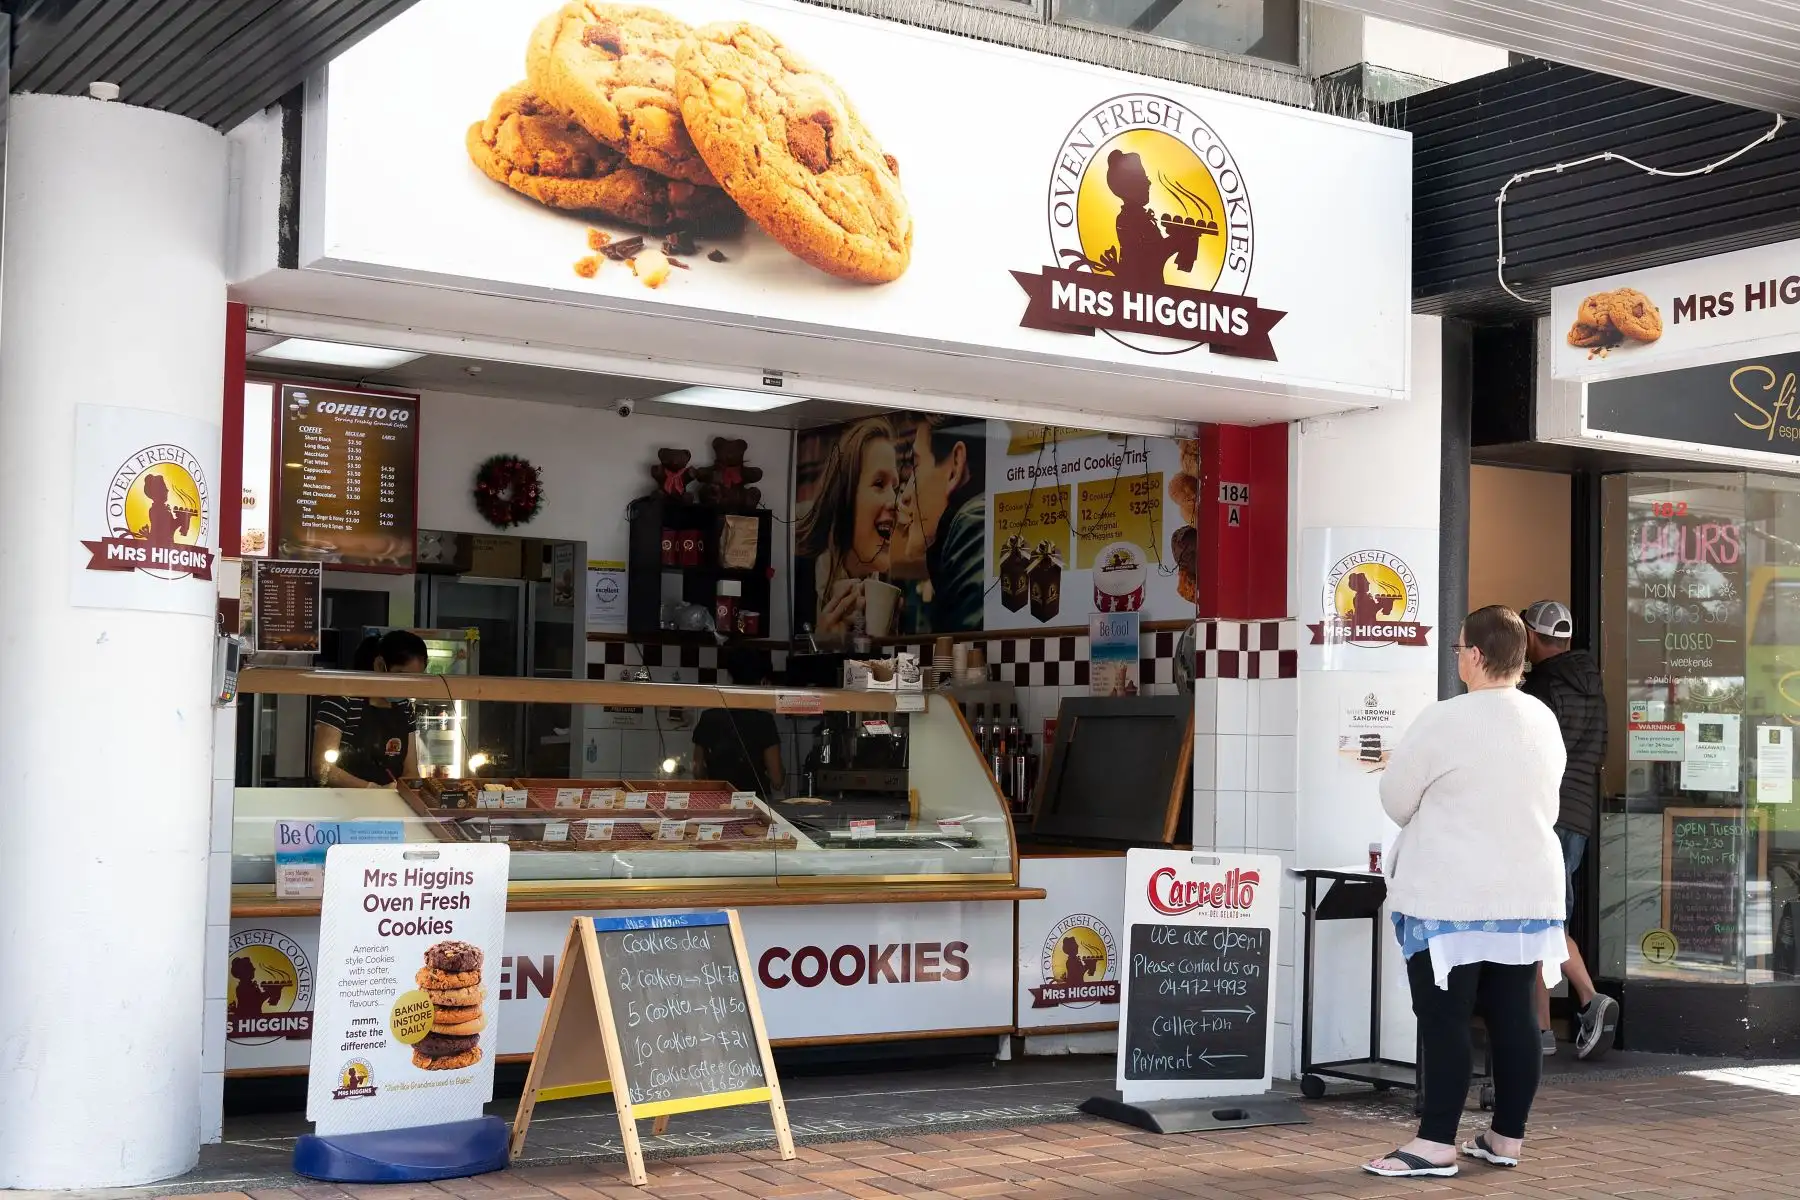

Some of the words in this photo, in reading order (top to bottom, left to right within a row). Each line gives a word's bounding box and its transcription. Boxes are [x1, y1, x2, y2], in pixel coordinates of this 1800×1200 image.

[1053, 128, 1096, 228] OVEN
[1092, 99, 1184, 137] FRESH
[1191, 127, 1248, 274] COOKIES
[1051, 280, 1114, 317] MRS
[1122, 290, 1249, 337] HIGGINS
[1673, 291, 1734, 325] MRS
[316, 401, 368, 417] COFFEE
[369, 407, 387, 419] TO
[389, 409, 410, 422] GO
[298, 425, 323, 434] COFFEE
[1006, 467, 1025, 482] Gift
[1028, 464, 1058, 480] Boxes
[1061, 458, 1081, 474] and
[1084, 453, 1123, 470] Cookie
[1123, 451, 1148, 465] Tins
[109, 465, 137, 518] OVEN
[135, 447, 185, 469] FRESH
[187, 460, 207, 536] COOKIES
[1081, 490, 1089, 501] 9
[1220, 484, 1249, 503] 184
[1081, 509, 1092, 520] 12
[1228, 508, 1240, 525] A
[1651, 502, 1689, 518] 182
[998, 519, 1008, 530] 12
[1641, 523, 1739, 565] HOURS
[107, 543, 147, 562] MRS
[151, 548, 207, 569] HIGGINS
[1341, 551, 1387, 570] FRESH
[1389, 558, 1417, 614] COOKIES
[1644, 583, 1676, 599] MON
[1099, 621, 1110, 637] Be
[1111, 620, 1129, 637] Cool
[1322, 625, 1352, 638] MRS
[1355, 625, 1417, 639] HIGGINS
[1664, 632, 1713, 651] CLOSED
[1670, 656, 1713, 668] weekends
[1638, 723, 1677, 731] WARNING
[280, 824, 301, 845] Be
[305, 824, 341, 845] Cool
[1675, 822, 1706, 837] OPEN
[1710, 822, 1756, 838] TUESDAY
[1689, 851, 1715, 866] MON
[363, 868, 398, 888] Mrs
[403, 866, 474, 890] Higgins
[1147, 866, 1260, 916] Carrello
[363, 893, 414, 913] Oven
[420, 890, 470, 911] Fresh
[1209, 910, 1219, 918] DEL
[1220, 910, 1239, 919] GELATO
[377, 916, 453, 937] Cookies
[352, 945, 389, 954] American
[622, 930, 678, 955] Cookies
[1043, 933, 1059, 970] OVEN
[1057, 915, 1091, 933] FRESH
[1092, 921, 1115, 973] COOKIES
[1150, 925, 1179, 945] We
[1183, 928, 1208, 946] are
[1213, 927, 1263, 958] open!
[228, 931, 274, 953] RESH
[278, 938, 311, 1002] COOKIES
[345, 957, 364, 966] style
[365, 955, 395, 964] Cookies
[758, 940, 970, 990] COOKIES
[1133, 953, 1176, 978] Please
[1223, 960, 1240, 975] us
[1242, 964, 1260, 978] on
[349, 967, 365, 976] with
[367, 966, 390, 975] softer,
[619, 967, 632, 992] 2
[338, 978, 369, 987] chewier
[369, 977, 398, 986] centres,
[339, 987, 396, 999] mouthwatering
[1042, 988, 1066, 1000] MRS
[1068, 984, 1116, 998] HIGGINS
[394, 1000, 430, 1017] BAKING
[628, 1001, 641, 1027] 5
[238, 1017, 309, 1033] HIGGINS
[351, 1017, 379, 1026] mmm,
[393, 1010, 432, 1028] INSTORE
[1152, 1015, 1232, 1037] Collection
[345, 1029, 367, 1039] taste
[369, 1028, 384, 1037] the
[400, 1022, 427, 1037] DAILY
[340, 1040, 387, 1051] difference!
[634, 1035, 653, 1069] 10
[650, 1066, 688, 1088] Cookie
[688, 1060, 724, 1080] Coffee
[728, 1057, 763, 1078] Combo
